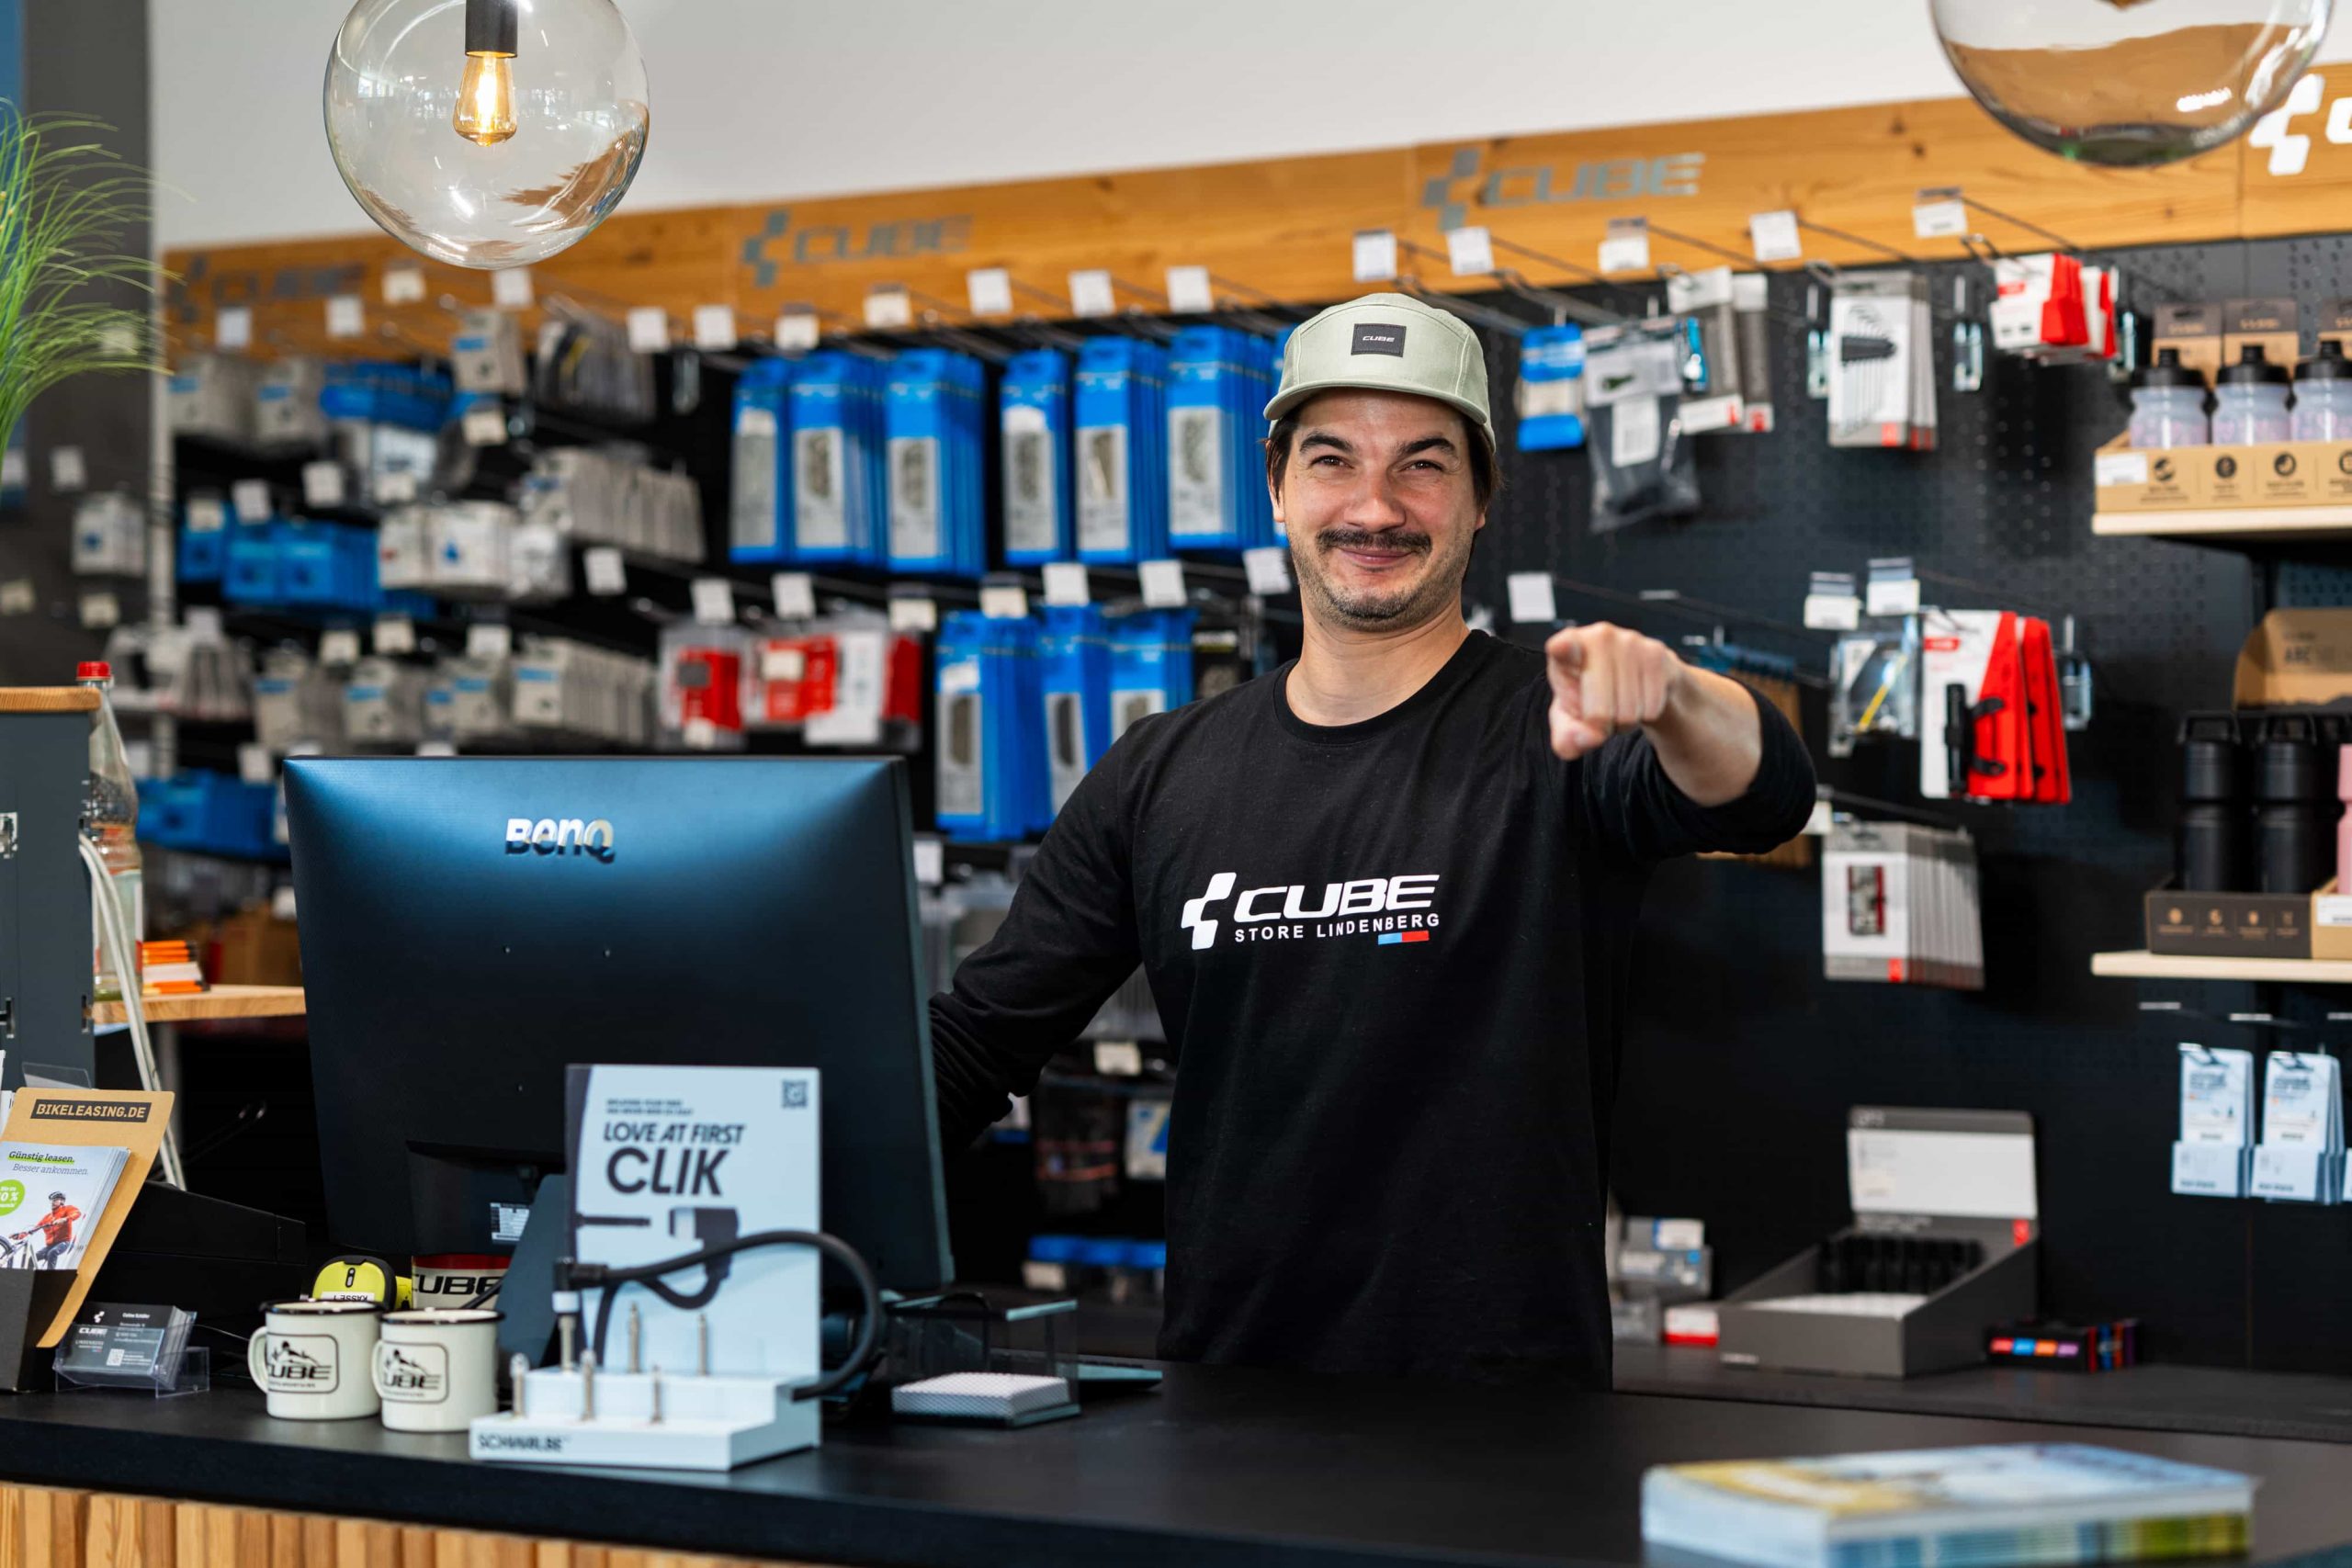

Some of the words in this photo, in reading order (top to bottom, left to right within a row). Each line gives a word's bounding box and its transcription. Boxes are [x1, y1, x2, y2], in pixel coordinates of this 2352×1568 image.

[1483, 152, 1706, 209] CUBE
[1234, 874, 1441, 923] CUBE
[1234, 924, 1305, 942] STORE
[1317, 912, 1441, 939] LINDENBERG
[36, 1103, 147, 1118] BIKELEASING.DE
[604, 1122, 657, 1142] LOVE
[660, 1123, 687, 1143] AT
[690, 1123, 745, 1144] FIRST
[8, 1151, 44, 1162] Günstig
[44, 1154, 74, 1163] leasen.
[13, 1163, 40, 1172] Besser
[40, 1165, 89, 1175] ankommen.
[606, 1146, 729, 1196] CLIK
[412, 1274, 503, 1294] UBE
[384, 1374, 442, 1389] UBE
